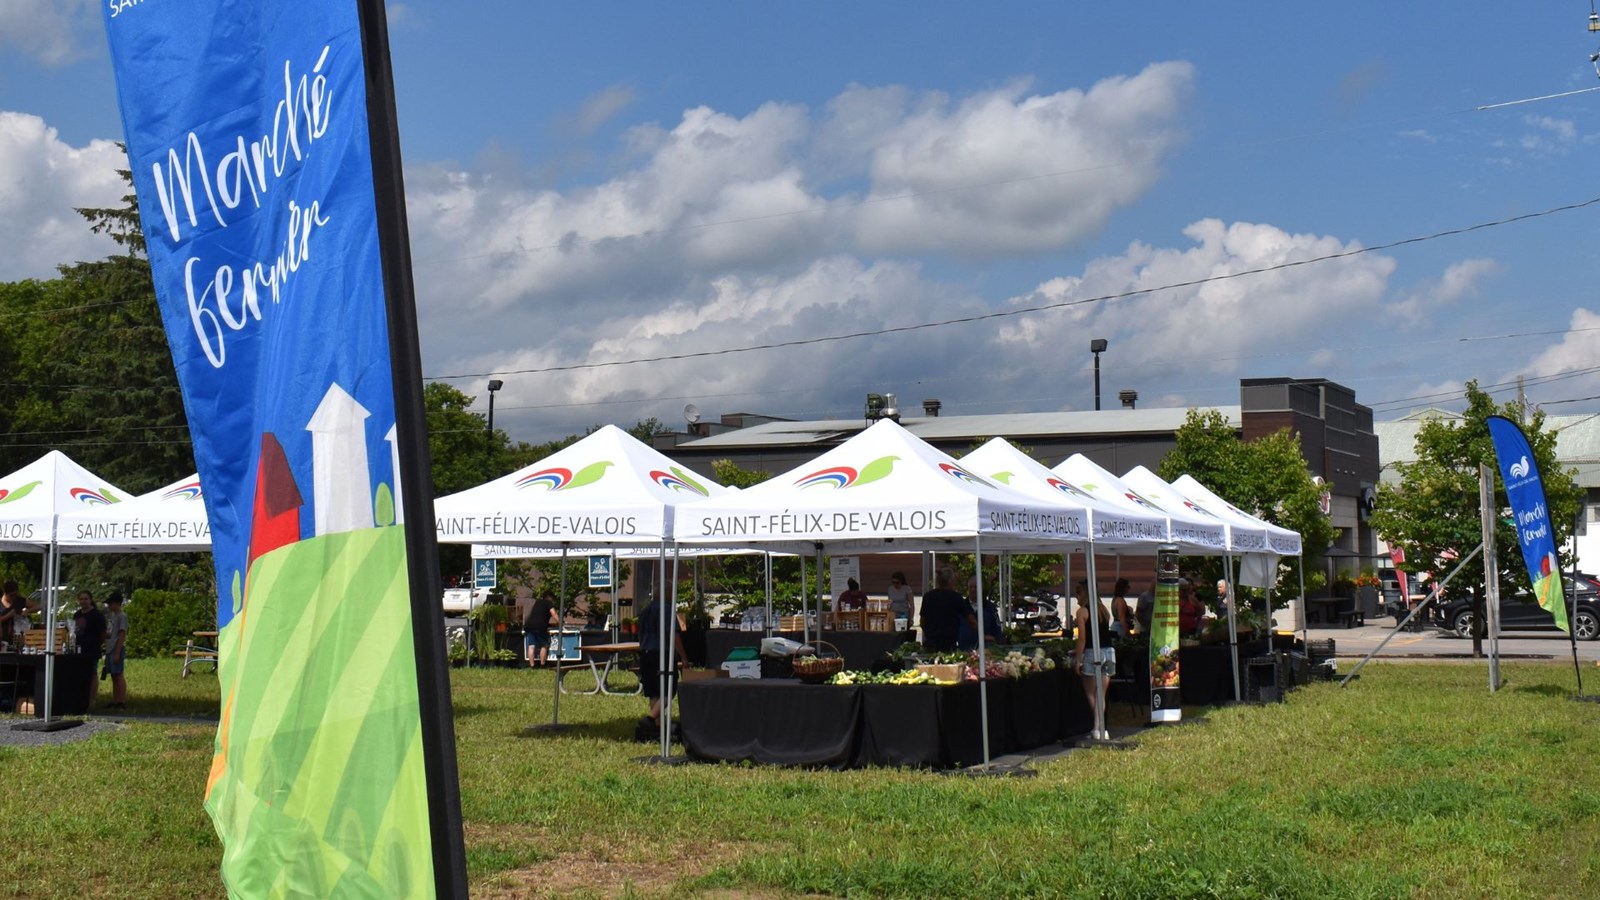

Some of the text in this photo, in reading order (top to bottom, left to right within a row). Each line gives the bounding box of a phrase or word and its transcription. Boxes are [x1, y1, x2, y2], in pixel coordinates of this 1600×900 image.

[153, 45, 332, 242] Marché
[76, 517, 210, 539] SAINT-FÉLIX-DE-VA
[436, 511, 636, 535] AINT-FÉLIX-DE-VALOIS
[702, 509, 946, 536] SAINT-FÉLIX-DE-VALOIS
[990, 508, 1080, 535] SAINT-FÉLIX-DE-VALOIS
